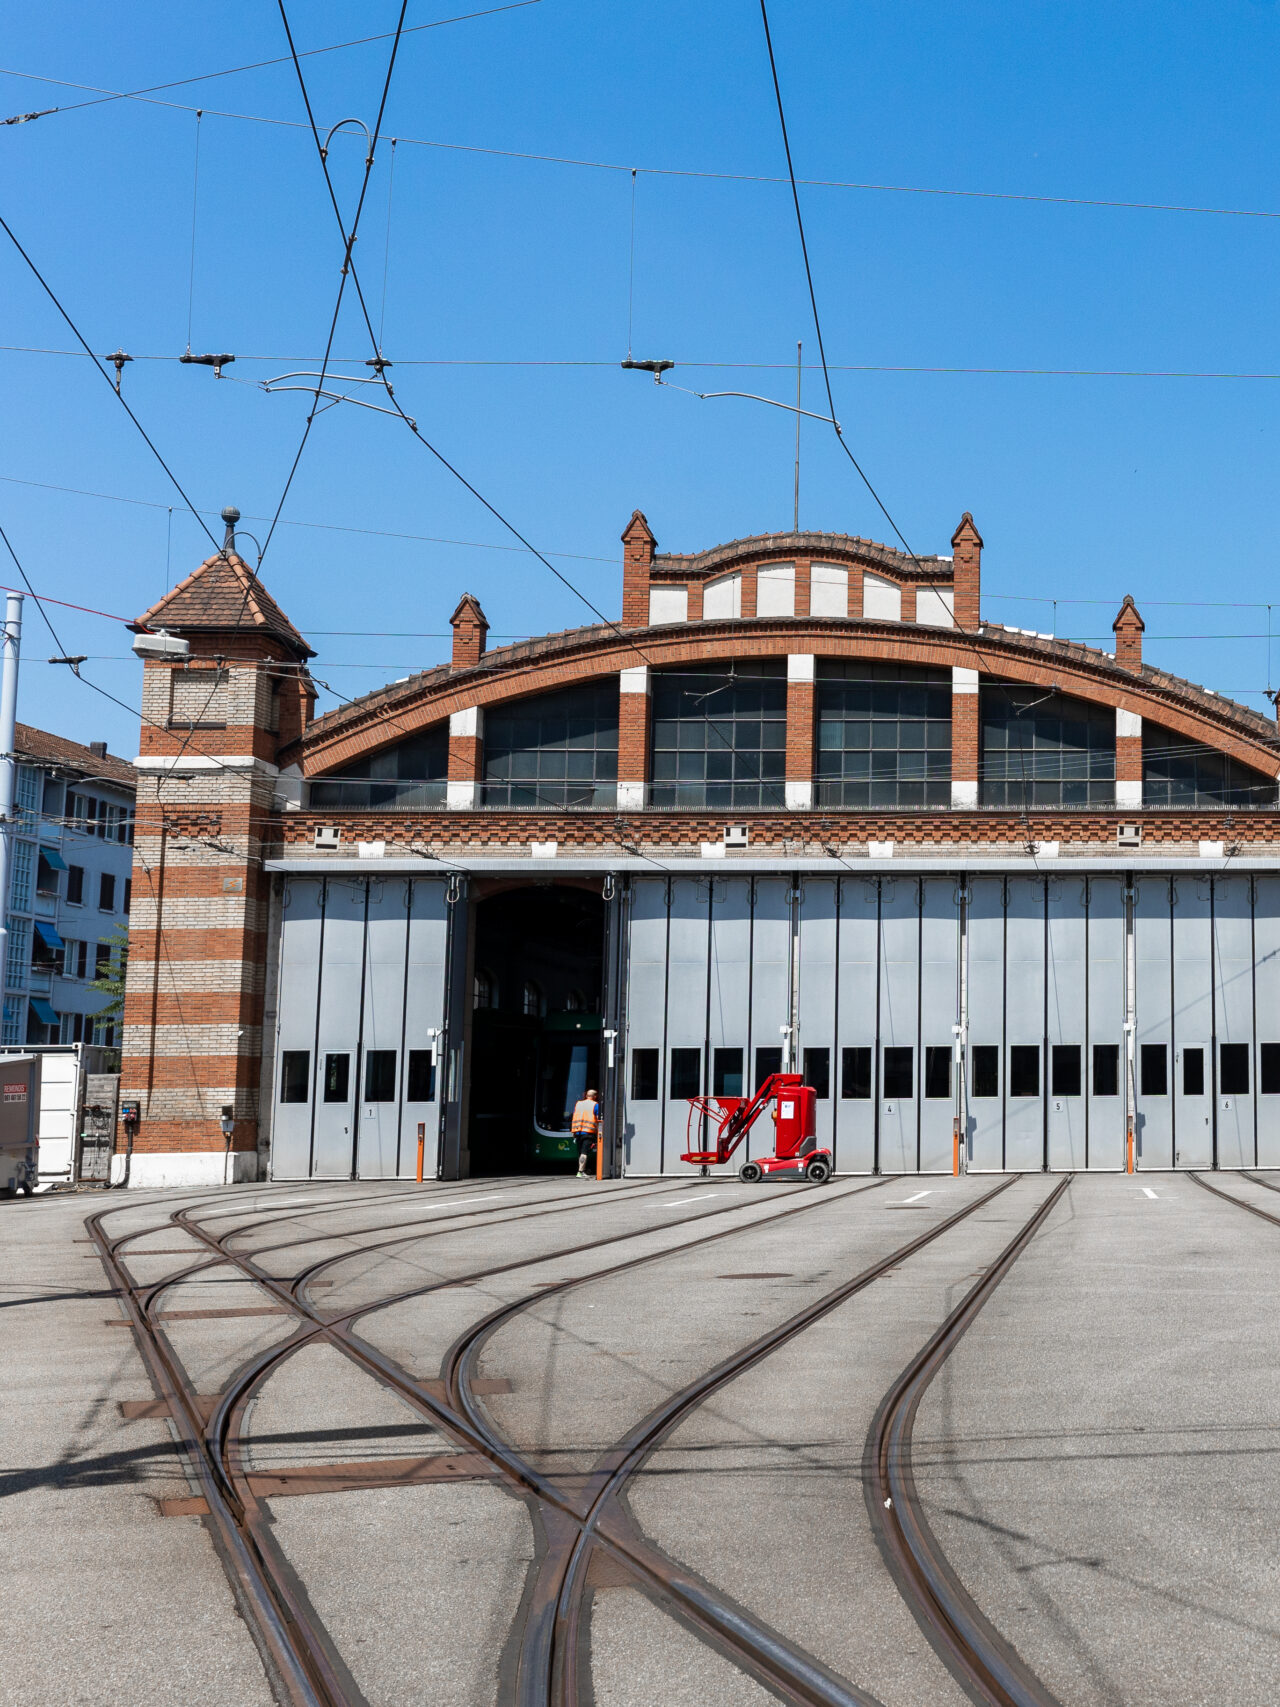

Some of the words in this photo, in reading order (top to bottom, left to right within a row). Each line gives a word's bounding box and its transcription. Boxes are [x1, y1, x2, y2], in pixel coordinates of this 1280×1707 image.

[1056, 1102, 1061, 1110] 5
[1224, 1100, 1229, 1108] 6
[369, 1109, 373, 1117] 1
[887, 1105, 892, 1113] 4
